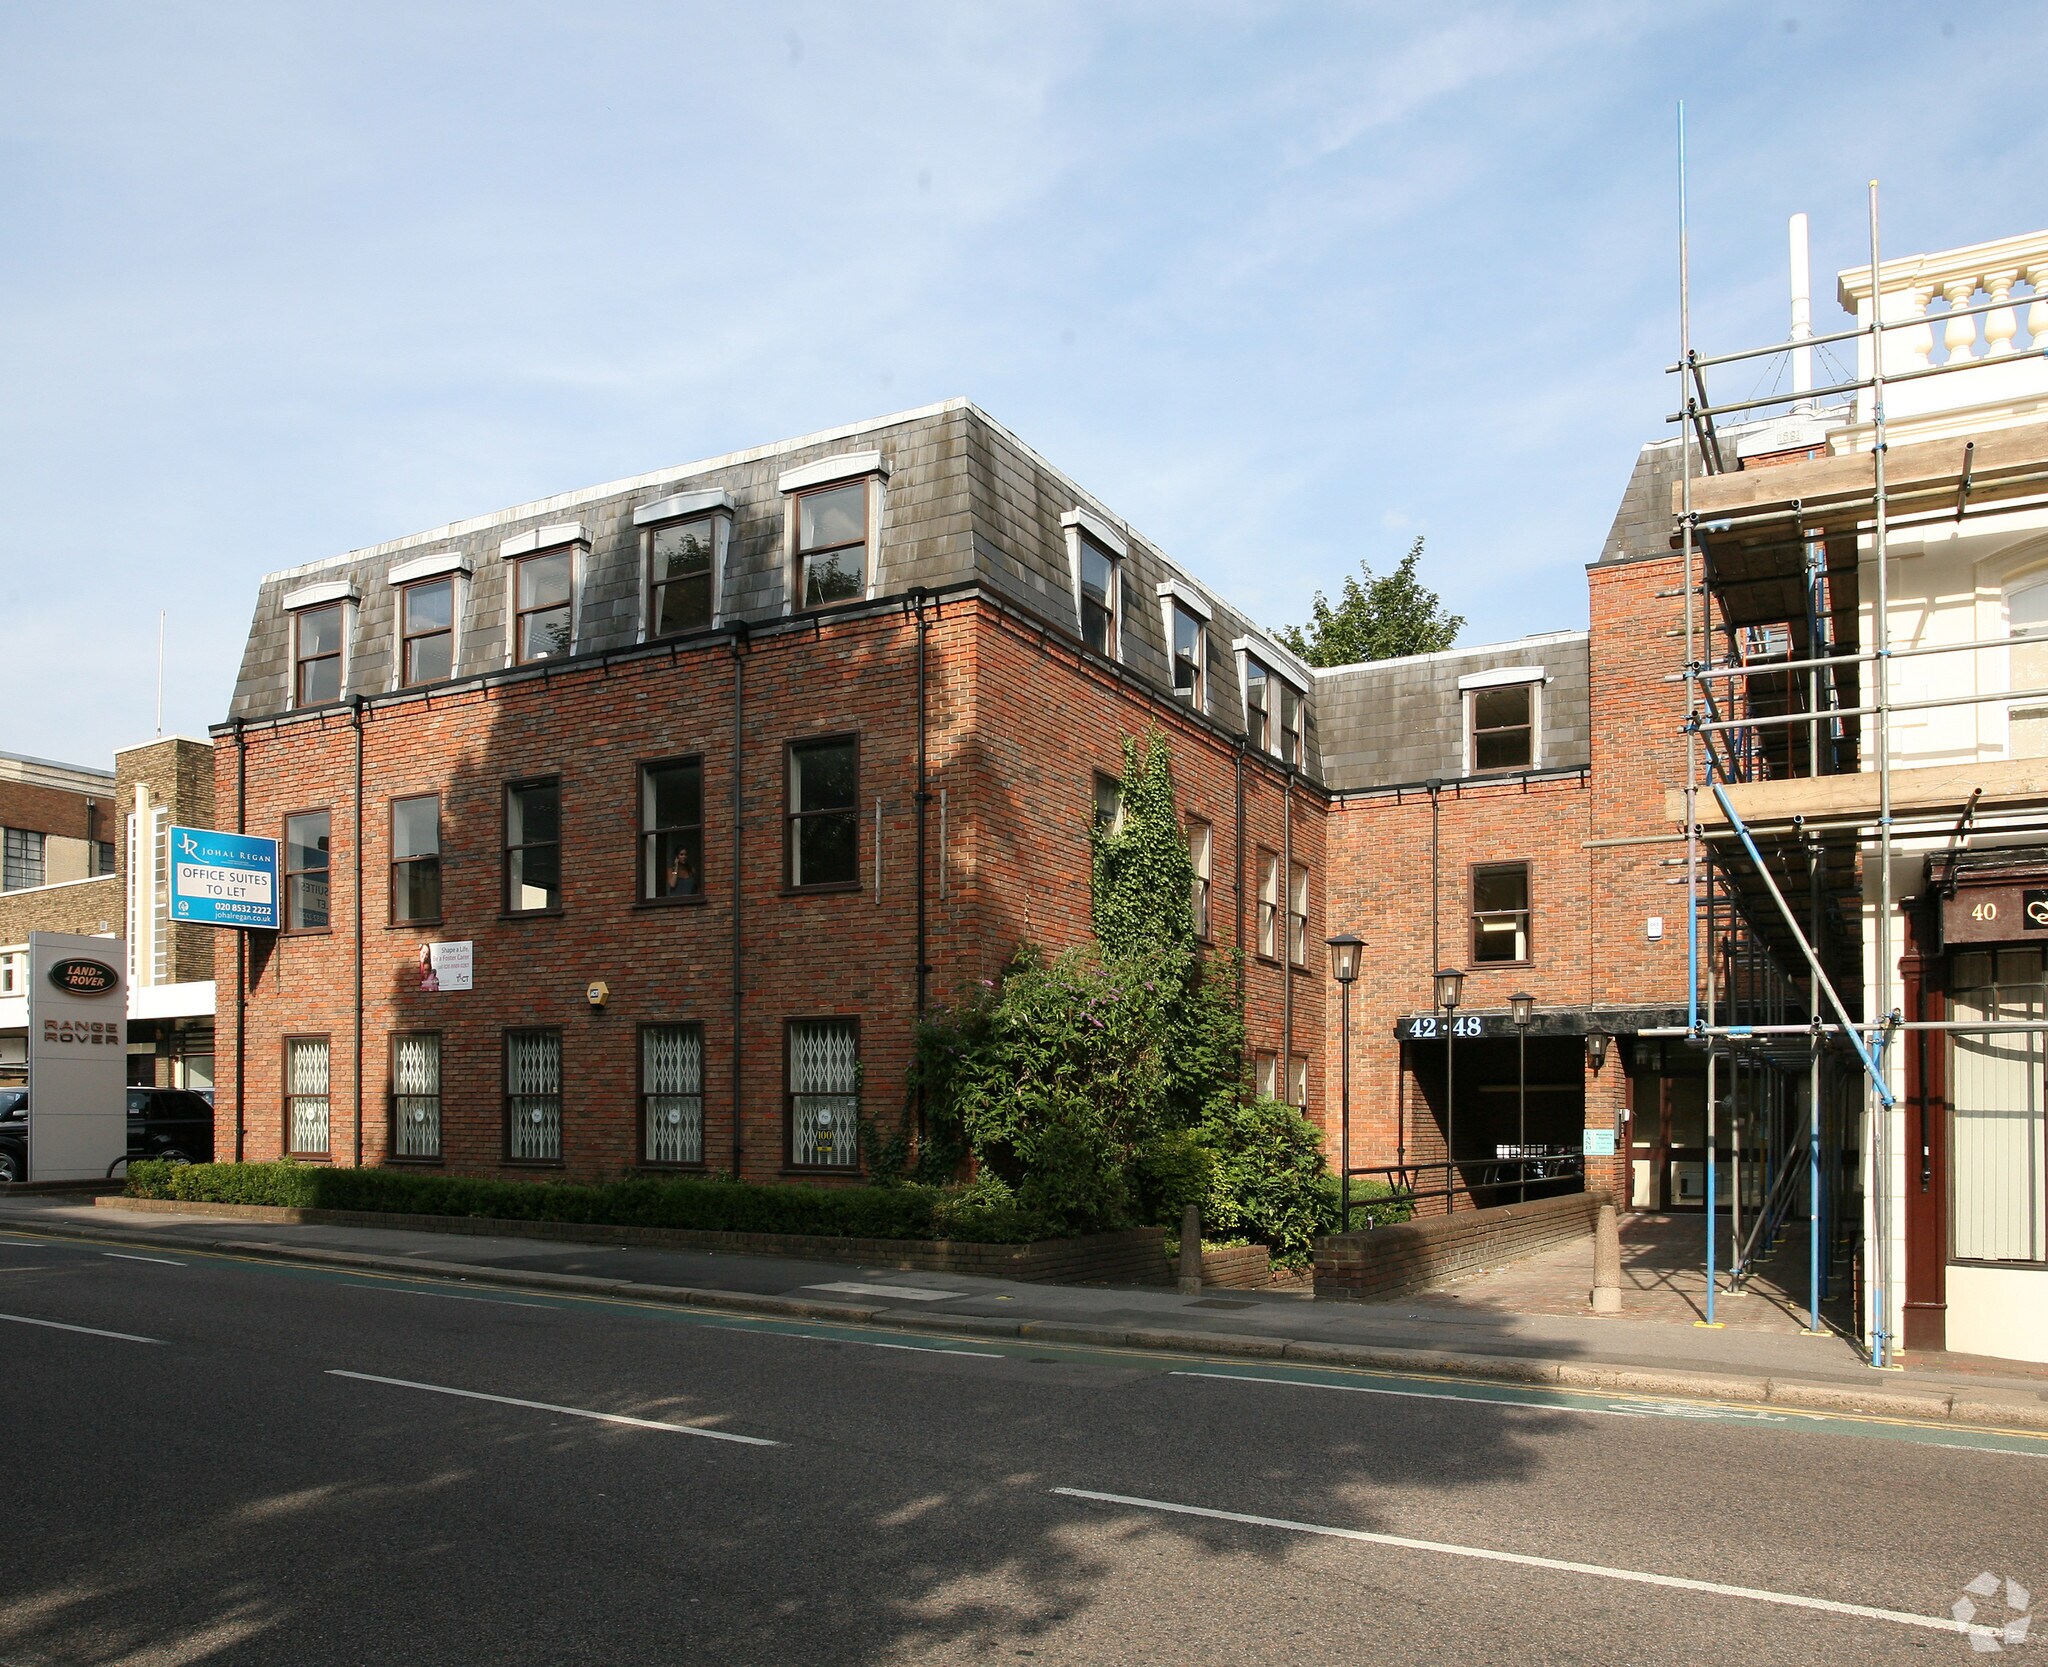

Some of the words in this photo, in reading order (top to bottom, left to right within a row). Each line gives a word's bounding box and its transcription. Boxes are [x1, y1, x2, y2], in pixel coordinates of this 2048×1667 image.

[201, 847, 234, 858] JOHAL
[239, 851, 271, 863] REGAN
[182, 867, 225, 882] OFFICE
[229, 871, 268, 886] SUITES
[206, 884, 223, 895] TO
[227, 886, 246, 898] LET
[215, 902, 231, 911] 020
[231, 903, 251, 913] 8532
[252, 905, 271, 915] 2222
[1971, 903, 1997, 921] 40
[215, 911, 271, 923] johalregan.co.uk
[441, 946, 456, 955] Shape
[67, 965, 96, 977] LAND
[69, 976, 105, 987] ROVER
[44, 1019, 117, 1033] RANGE
[1409, 1017, 1437, 1038] 42
[1452, 1016, 1482, 1037] 48
[44, 1032, 119, 1045] ROVER
[818, 1130, 832, 1140] 100
